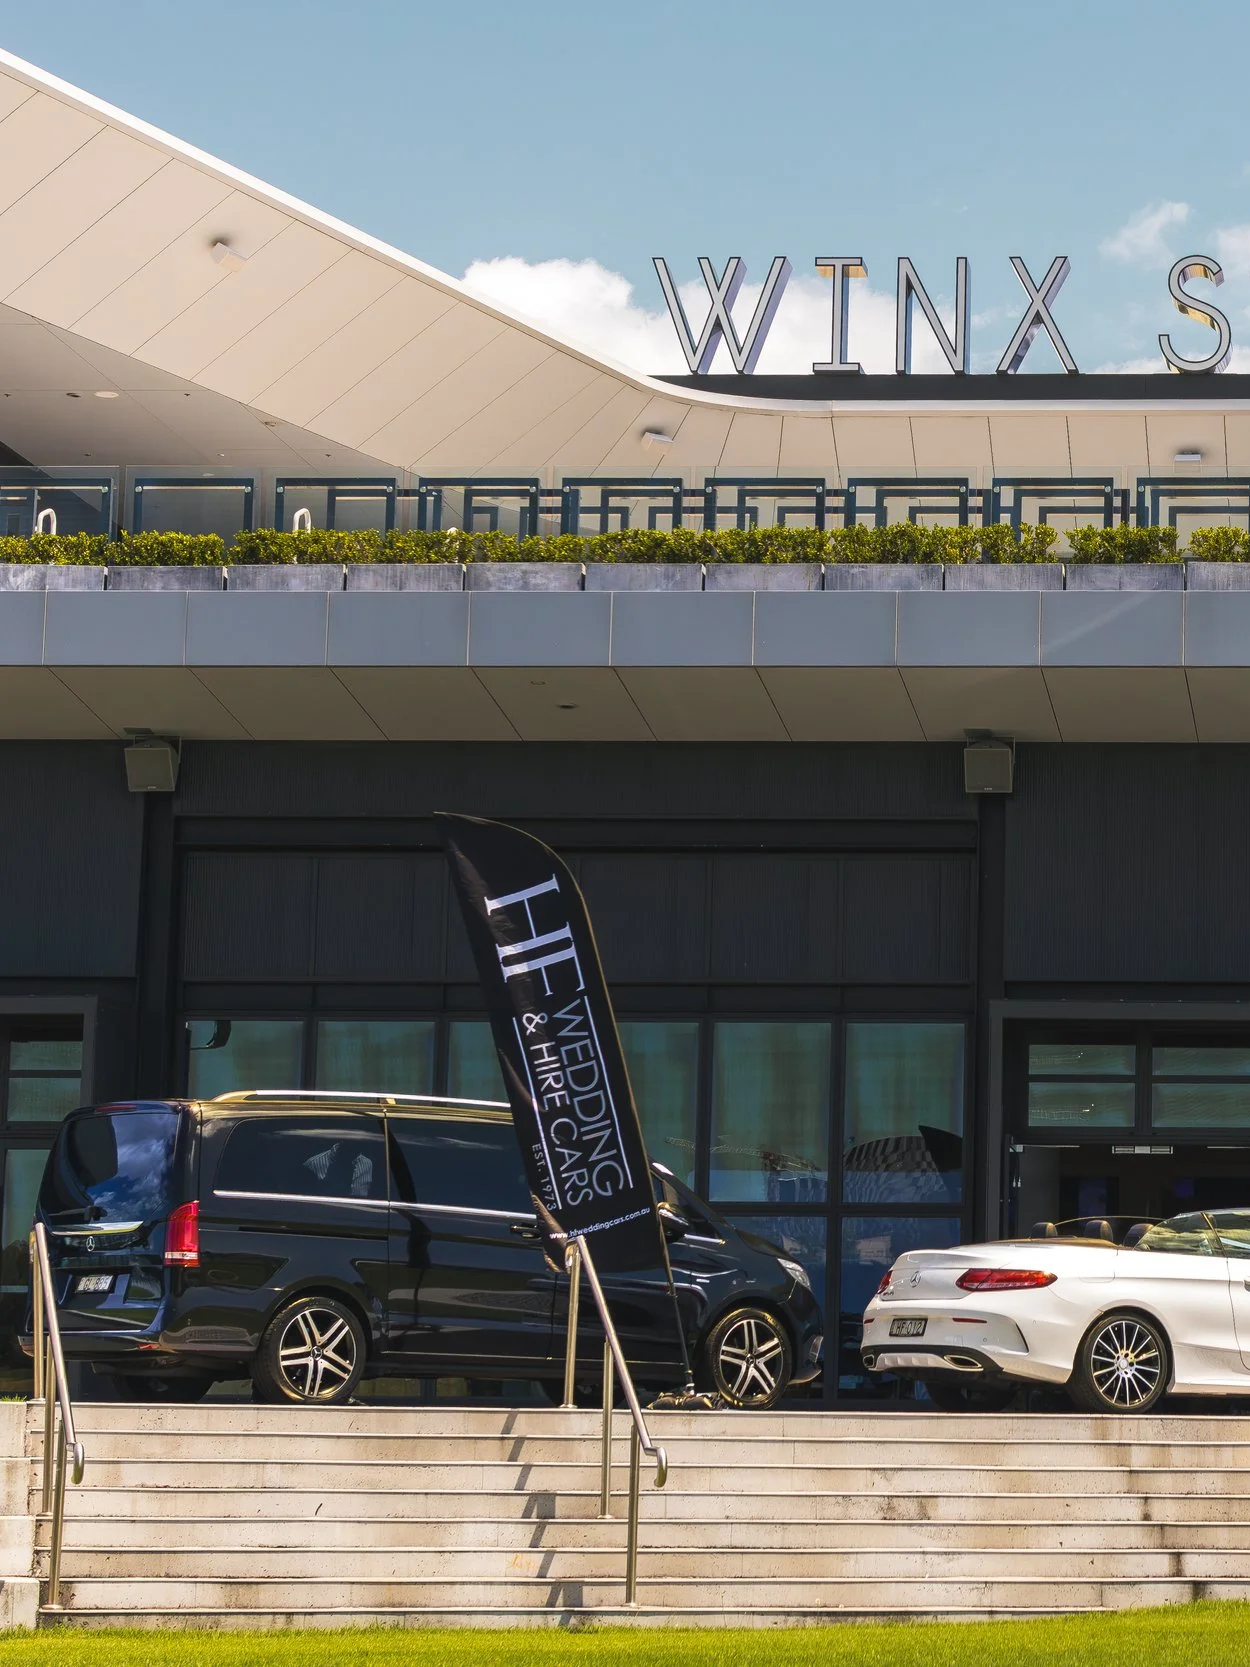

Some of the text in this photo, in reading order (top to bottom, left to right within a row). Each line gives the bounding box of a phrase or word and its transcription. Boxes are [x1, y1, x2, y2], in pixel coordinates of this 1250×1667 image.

[651, 255, 1078, 375] WINX
[484, 873, 586, 996] HF
[522, 1012, 594, 1206] & HIRE CARS
[552, 998, 625, 1197] WEDDING
[531, 1143, 557, 1211] EST. 1973
